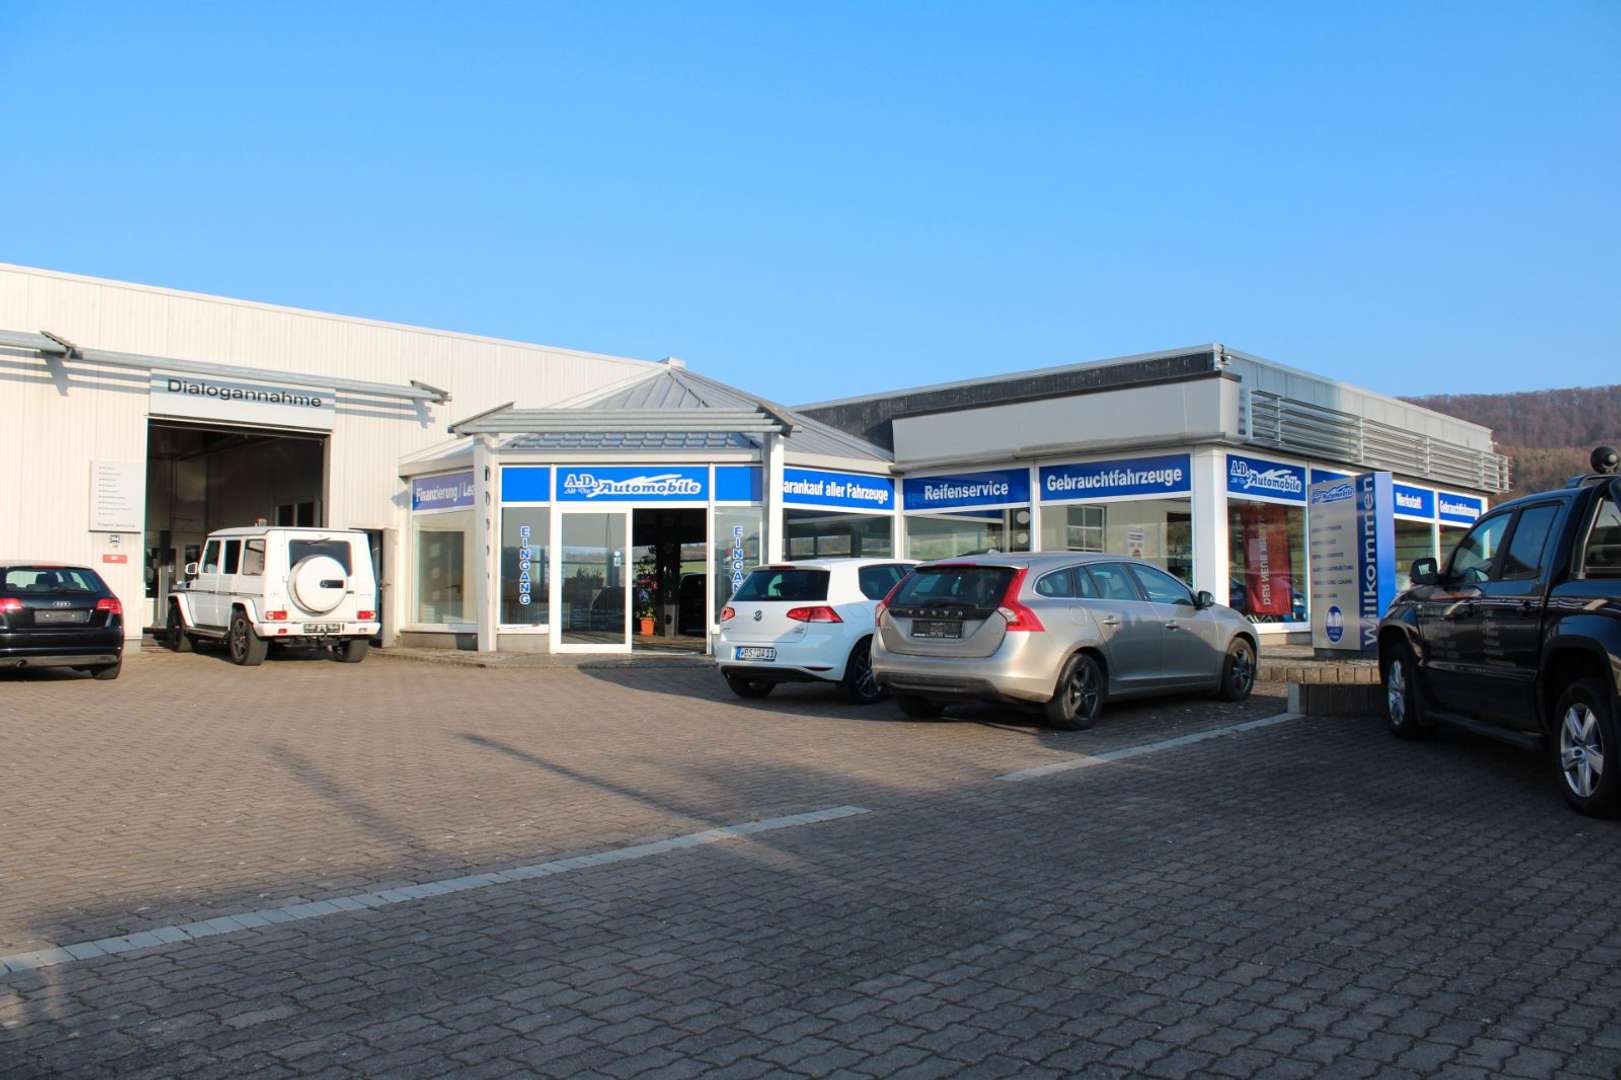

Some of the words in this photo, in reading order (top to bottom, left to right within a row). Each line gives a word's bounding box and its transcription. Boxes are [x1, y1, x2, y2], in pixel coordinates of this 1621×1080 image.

[167, 378, 322, 408] Dialogannahme
[598, 478, 701, 496] Automobile
[924, 480, 1009, 501] Reifenservice
[1046, 466, 1182, 491] Gebrauchtfahrzeuge
[1249, 469, 1302, 493] Automobile
[416, 484, 458, 503] Finanzierung
[783, 479, 823, 496] arankauf
[825, 481, 845, 498] aller
[846, 483, 888, 504] Fahrzeuge
[519, 526, 531, 605] EINGANG
[732, 526, 743, 594] EINGAN
[1362, 477, 1378, 646] Willkommen
